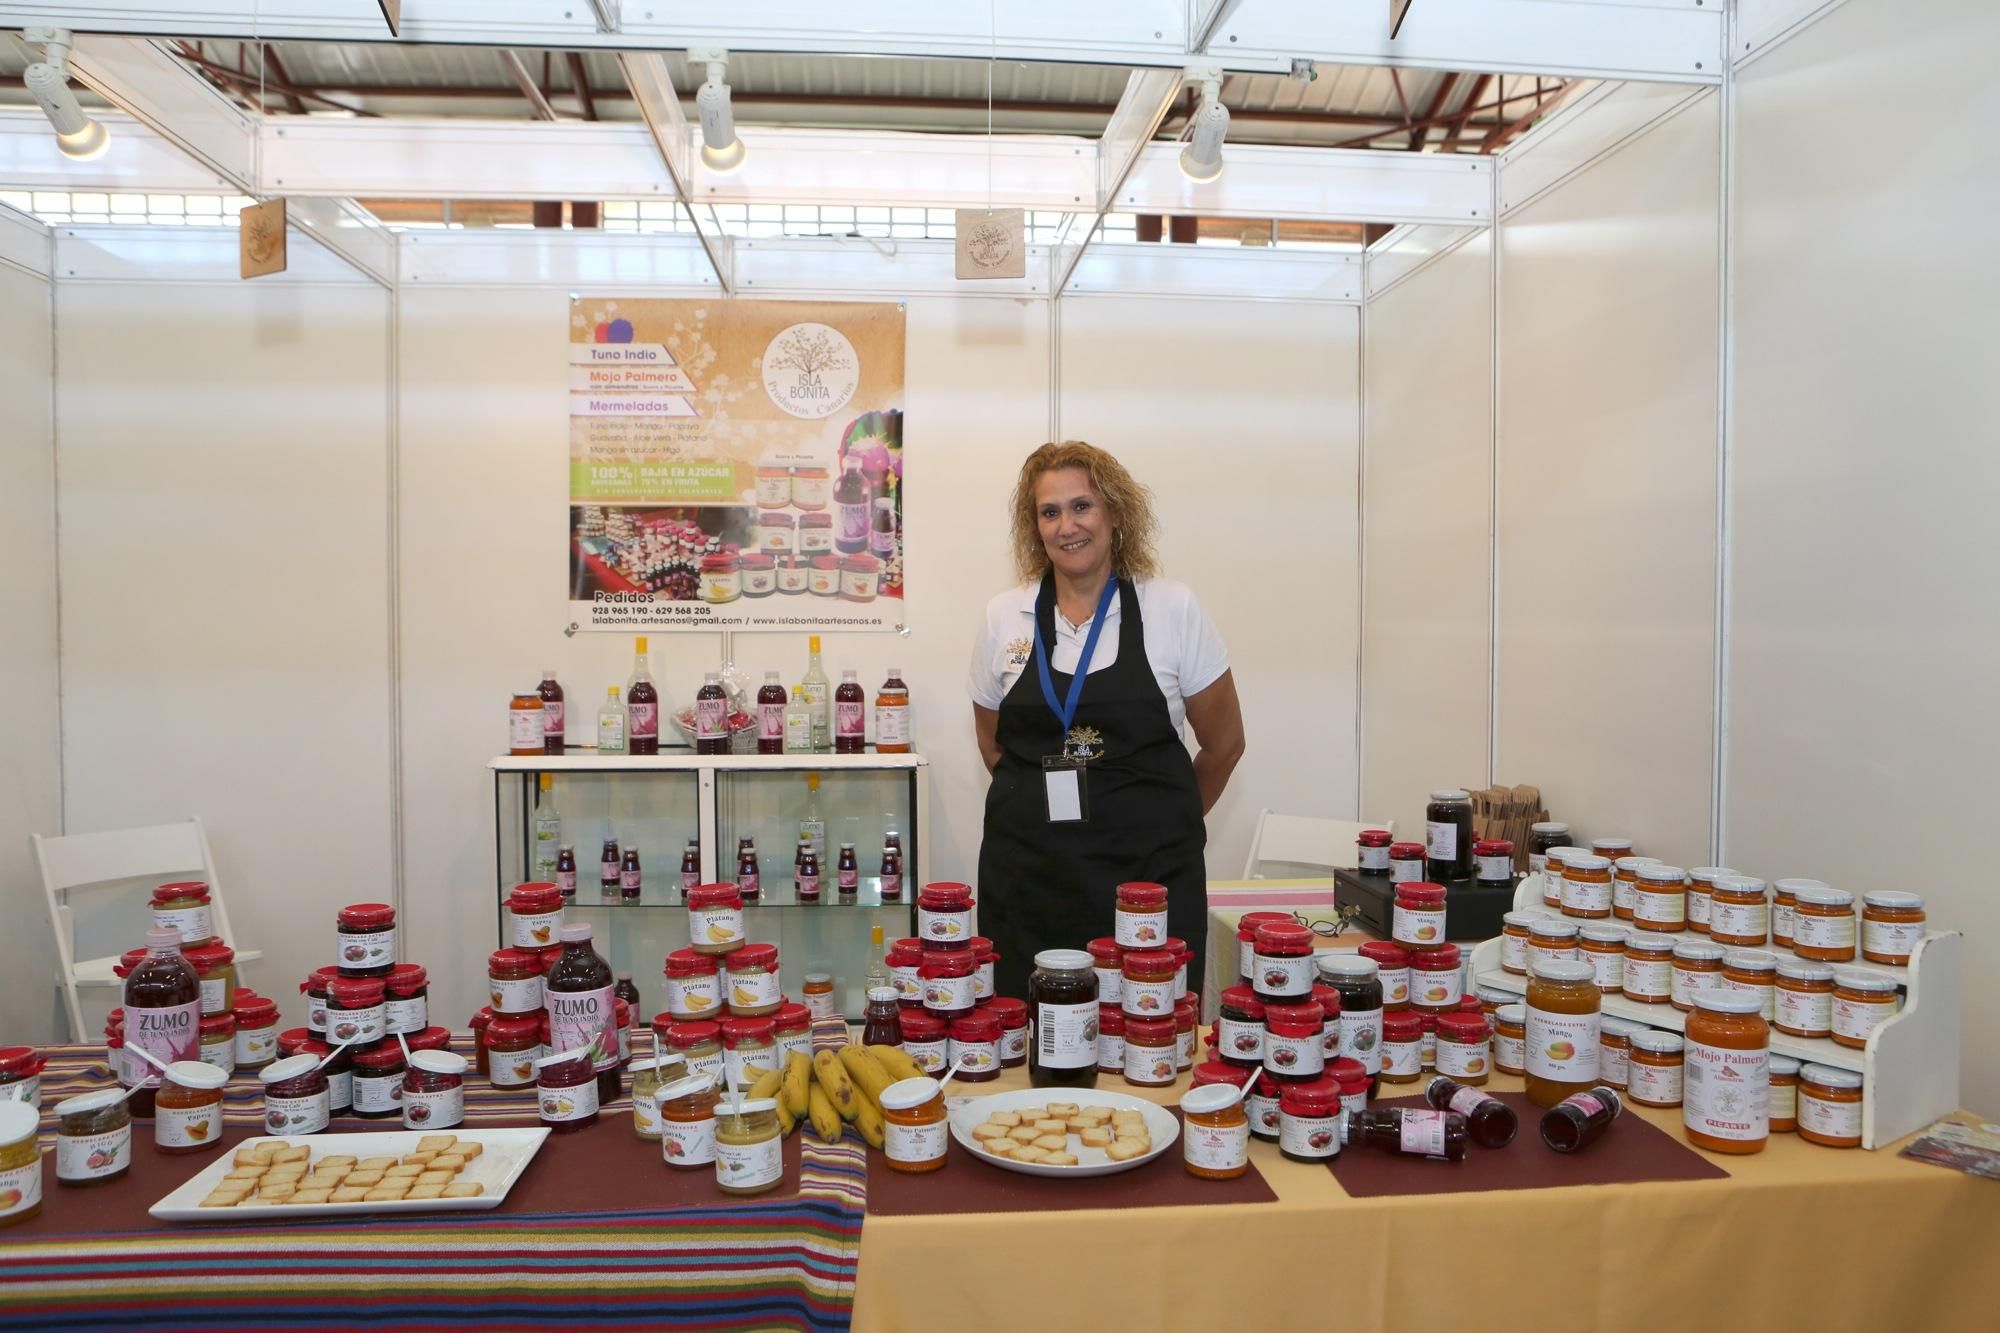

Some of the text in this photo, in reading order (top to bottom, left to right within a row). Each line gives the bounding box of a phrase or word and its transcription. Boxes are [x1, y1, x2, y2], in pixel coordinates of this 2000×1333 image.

[591, 349, 657, 360] Tuno Indio
[590, 371, 677, 383] Mojo Palmero
[798, 374, 822, 386] ISLA
[790, 386, 830, 399] BONITA
[768, 380, 855, 416] Productos Canarios
[590, 401, 668, 412] Mermeladas
[635, 422, 663, 432] Mango
[669, 422, 699, 432] Papaya
[590, 434, 627, 444] Guayaba
[633, 434, 652, 442] Aloe
[653, 434, 671, 442] Vera
[590, 446, 619, 455] Mango
[591, 466, 633, 479] 100%
[640, 465, 729, 477] BAJA EN AZÚCAR
[839, 505, 867, 514] ZUMO
[594, 590, 655, 604] Pedidos
[592, 607, 608, 615] 928
[610, 607, 629, 615] 965
[632, 607, 648, 615] 190
[655, 607, 673, 615] 629
[675, 607, 692, 615] 568
[694, 607, 711, 615] 205
[592, 616, 742, 626] islabonita.artesanos@gmail.com
[753, 617, 882, 626] www.islabonitaartesanos.es
[544, 704, 560, 712] UMO
[700, 702, 720, 711] ZUMO
[838, 703, 858, 712] ZUMO
[706, 915, 734, 924] Plátano
[1416, 917, 1436, 925] Mango
[682, 983, 711, 993] Plátano
[731, 979, 759, 987] Plátano
[554, 998, 598, 1016] ZUMO
[139, 1010, 190, 1032] ZUMO
[581, 1014, 599, 1022] INDIO
[150, 1030, 170, 1038] TUNO
[1548, 1028, 1573, 1038] Mango
[742, 1054, 770, 1063] Plátano
[1695, 1047, 1764, 1066] Mojo Palmero
[1644, 1065, 1669, 1074] Palmero
[1708, 1120, 1749, 1129] PICANTE
